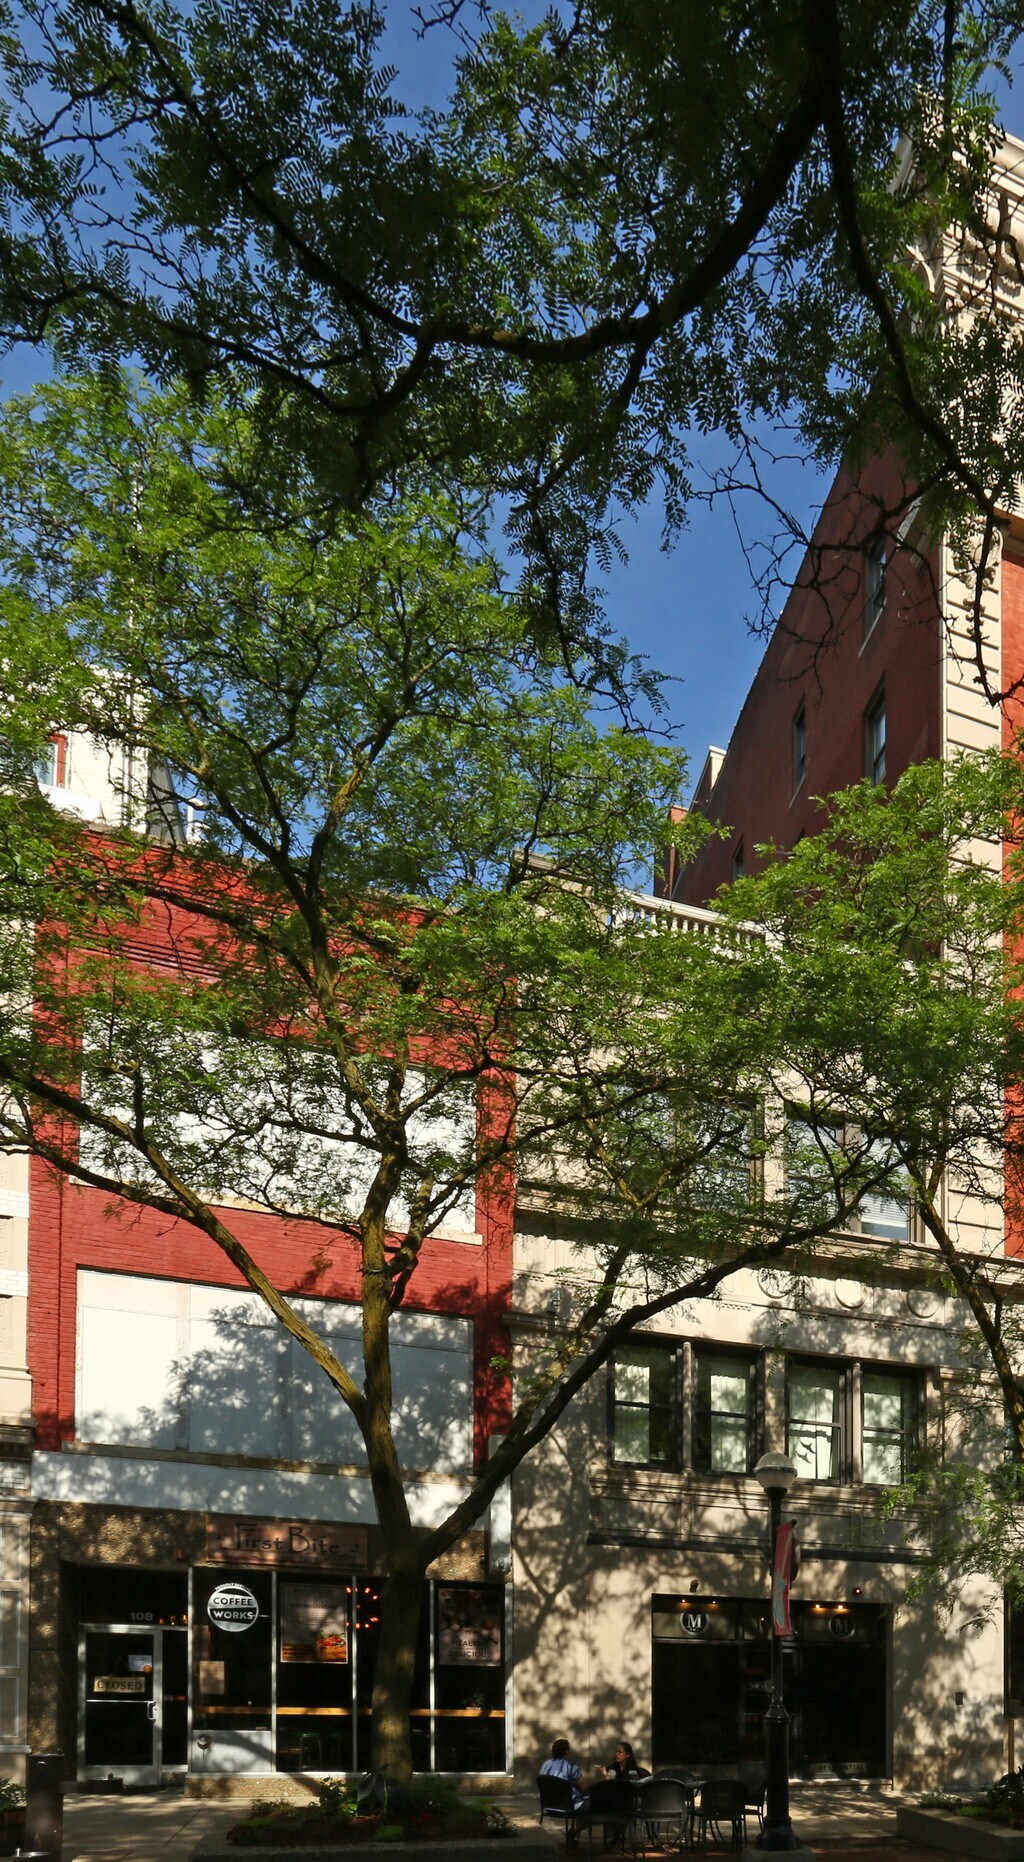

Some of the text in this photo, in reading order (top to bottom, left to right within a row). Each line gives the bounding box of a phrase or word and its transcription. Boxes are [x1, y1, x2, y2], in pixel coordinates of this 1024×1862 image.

[236, 1523, 341, 1553] First Bite
[213, 1597, 253, 1606] COFFEE
[130, 1611, 153, 1621] 108
[213, 1610, 254, 1620] WORKS
[687, 1613, 703, 1628] M
[448, 1650, 492, 1658] DELICIOUS
[97, 1680, 142, 1690] CLOSED
